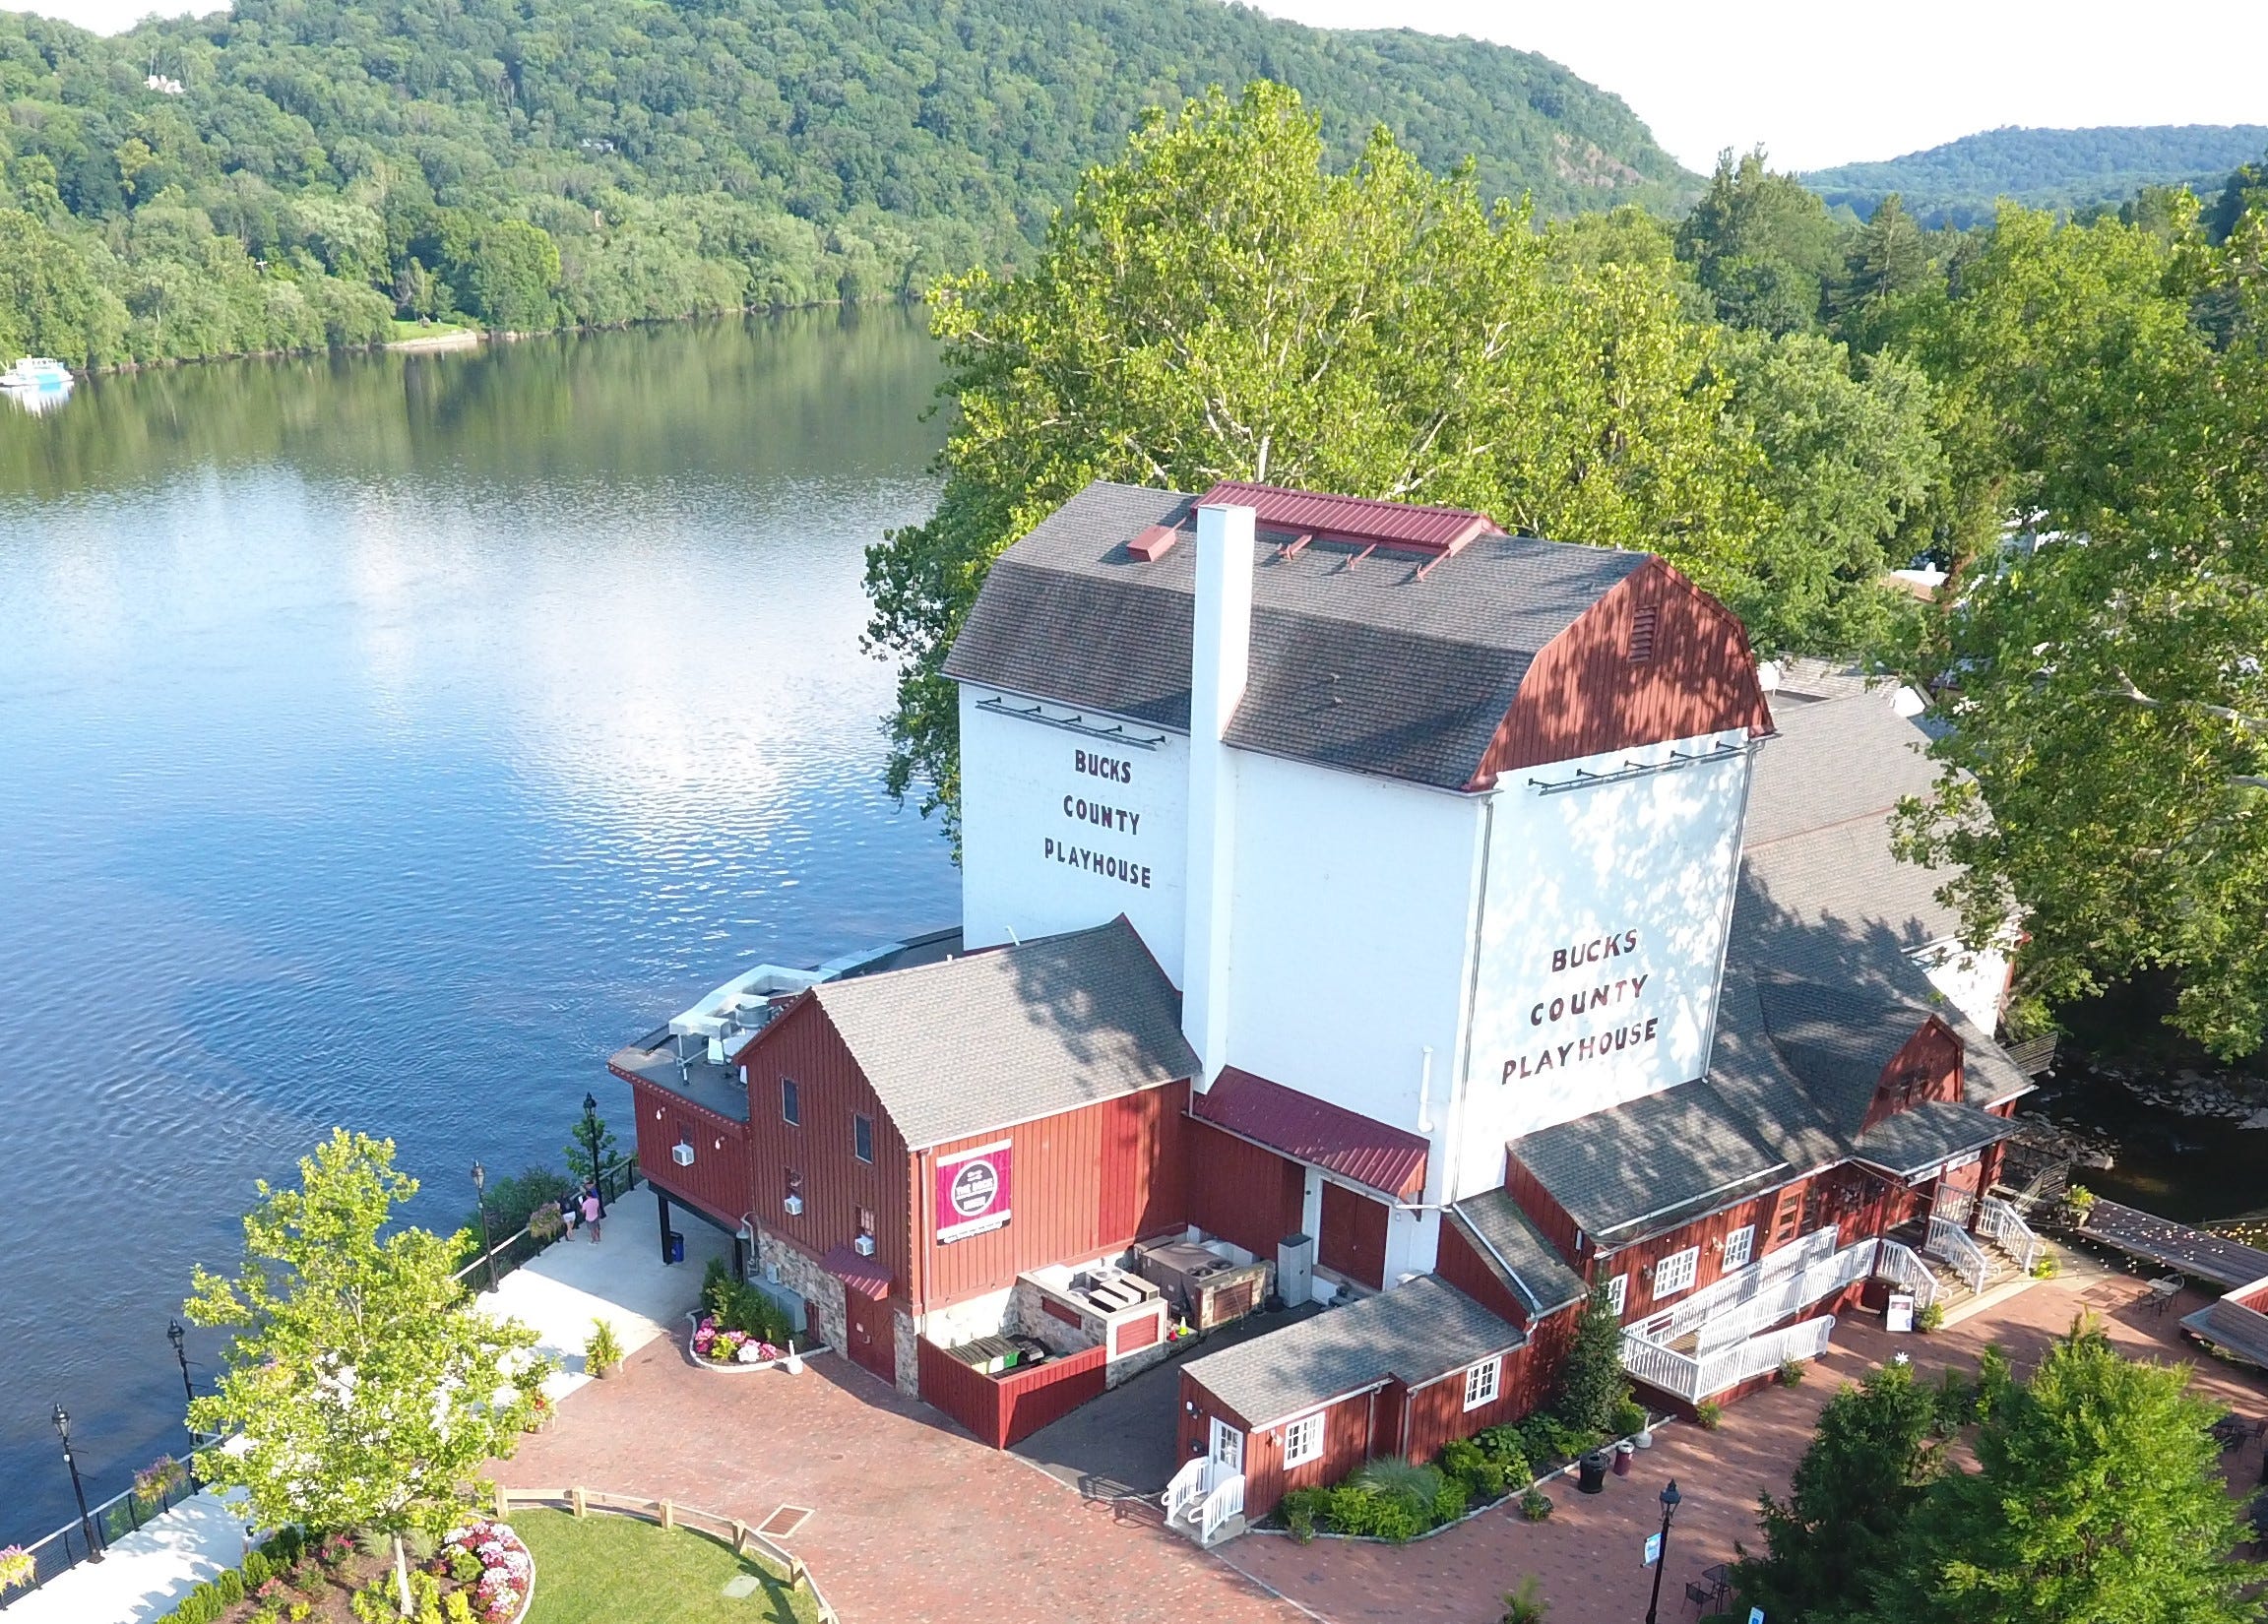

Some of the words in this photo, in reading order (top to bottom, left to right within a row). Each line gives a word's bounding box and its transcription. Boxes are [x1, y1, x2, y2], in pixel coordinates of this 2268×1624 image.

[1075, 749, 1131, 783] BUCKS
[1063, 794, 1140, 836] COUNTY
[1044, 838, 1151, 889] PLAYHOUSE
[1551, 928, 1637, 972] BUCKS
[1530, 973, 1649, 1027] COUNTY
[1501, 1017, 1659, 1086] PLAYHOUSE
